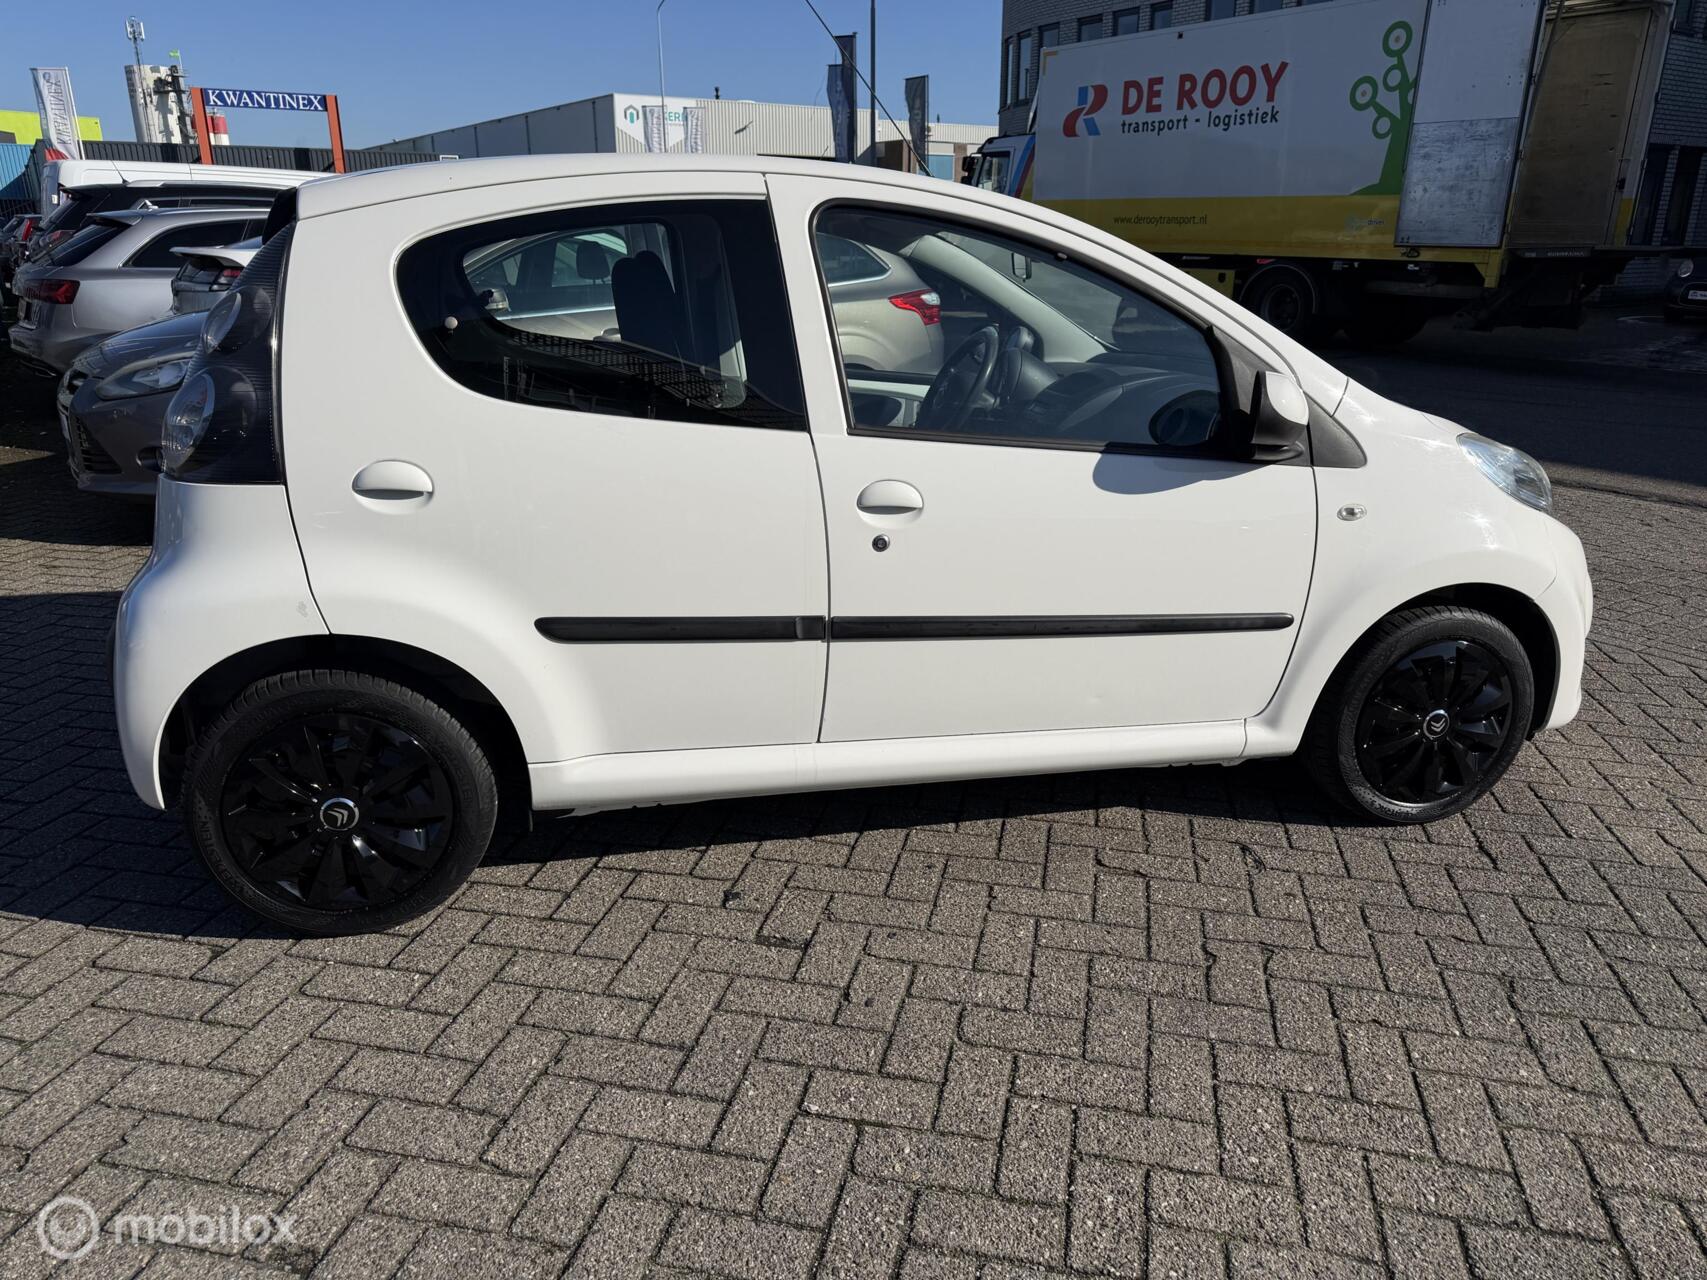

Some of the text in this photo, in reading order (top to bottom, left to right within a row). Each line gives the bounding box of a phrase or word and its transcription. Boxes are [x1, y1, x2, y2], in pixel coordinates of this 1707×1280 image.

[208, 89, 324, 111] KWANTINEX
[1121, 60, 1289, 115] DE ROOY
[1120, 114, 1189, 136] transport
[1207, 105, 1280, 131] logistiek
[1113, 214, 1208, 228] www.derooytransport.nl
